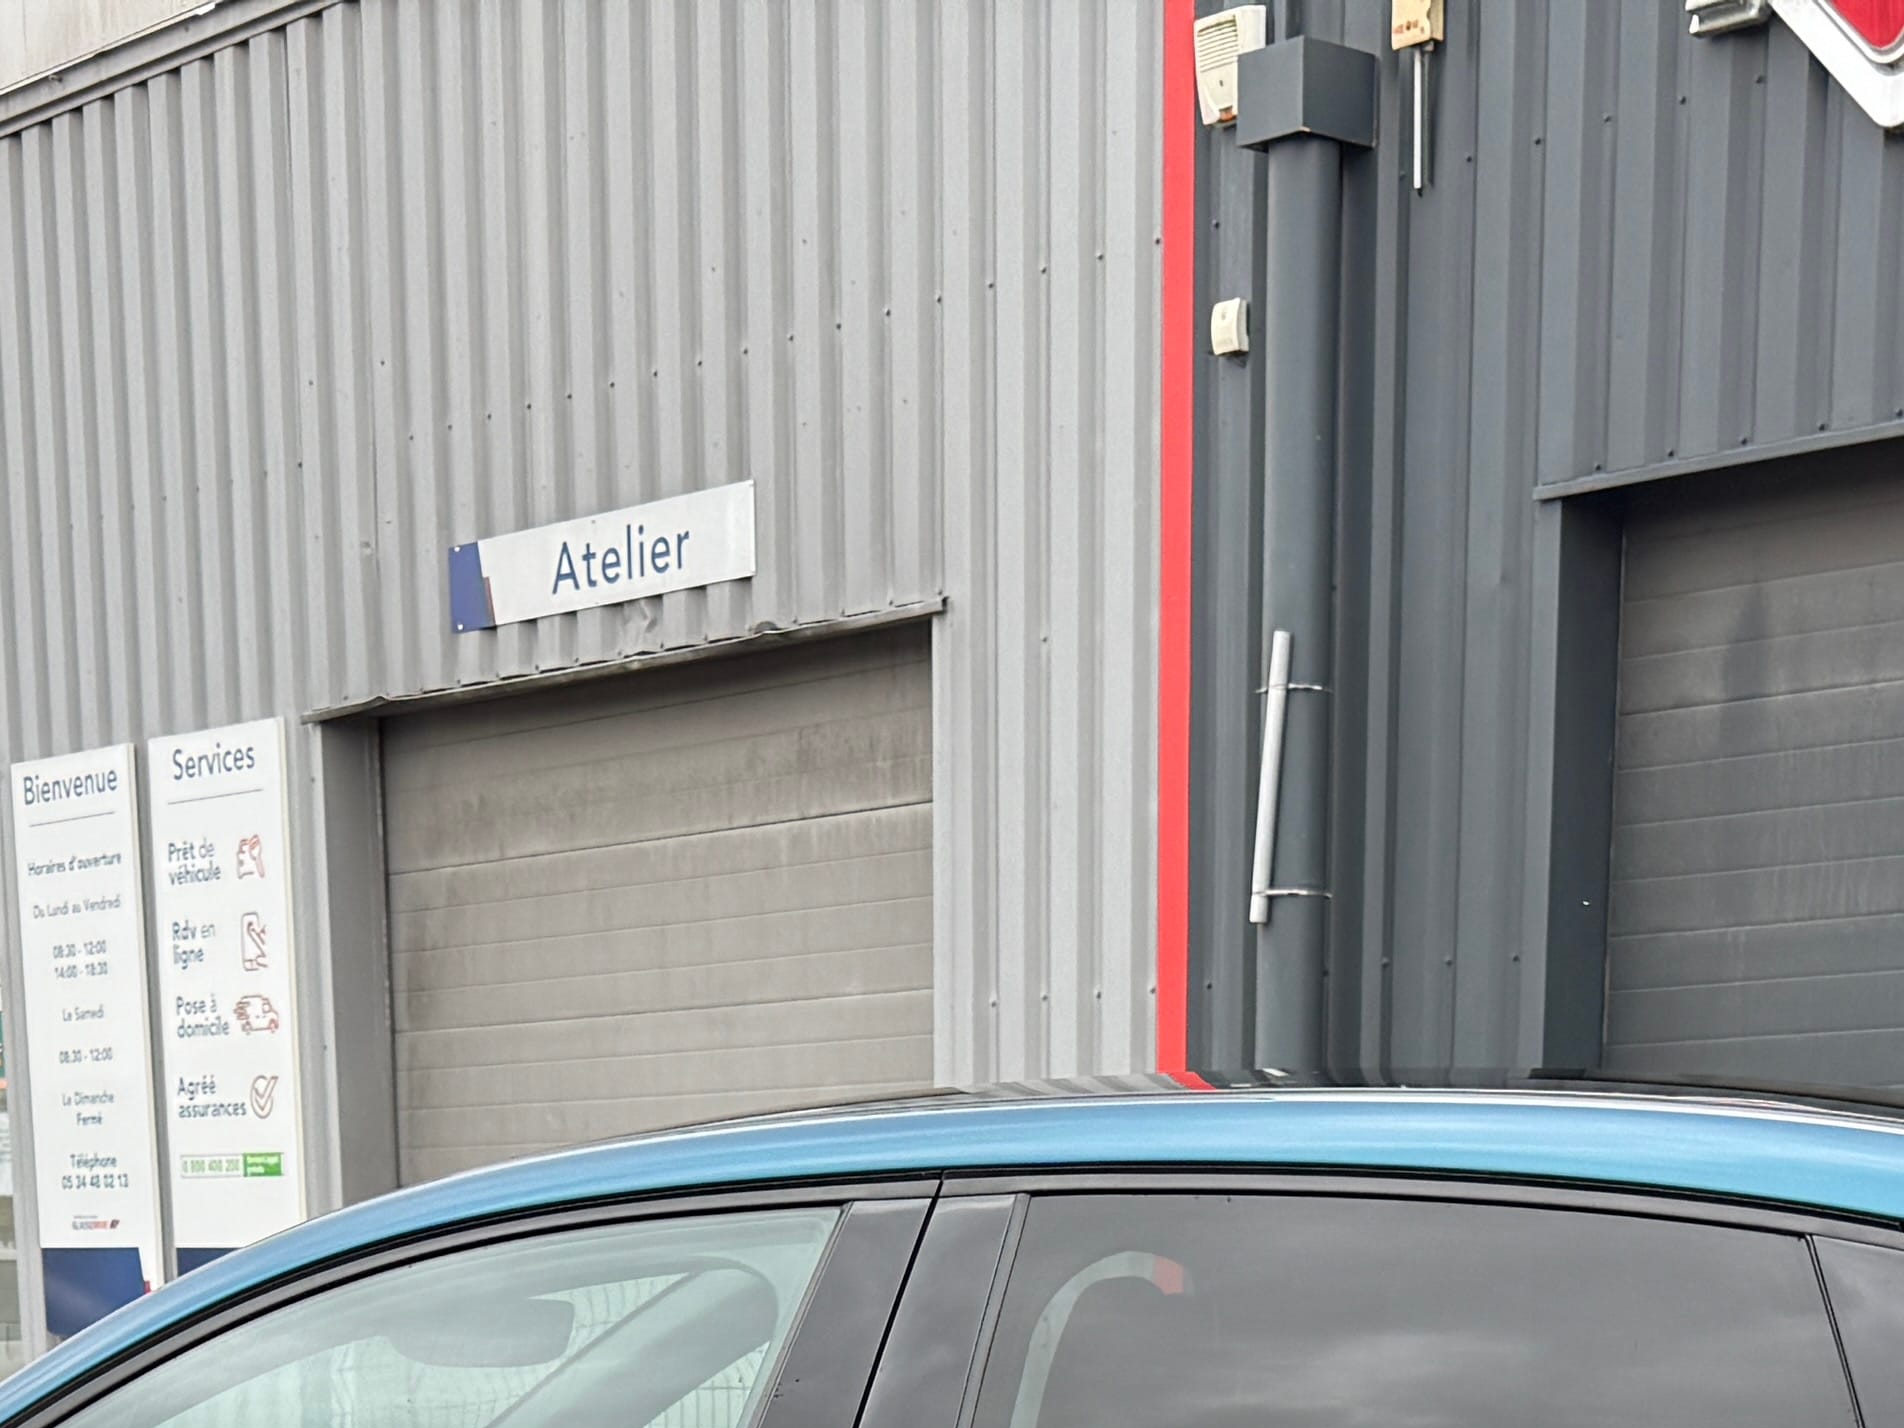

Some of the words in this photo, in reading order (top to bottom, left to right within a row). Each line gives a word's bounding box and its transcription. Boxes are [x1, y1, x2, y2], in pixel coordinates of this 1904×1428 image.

[552, 523, 690, 594] Atelier
[172, 743, 256, 781] Services
[23, 769, 118, 806] Bienvenue
[168, 841, 196, 863] Prêt
[199, 837, 215, 859] de
[168, 862, 222, 886] véhicule
[172, 920, 197, 942] Rdv
[200, 922, 216, 939] en
[173, 943, 205, 970] ligne
[176, 995, 208, 1016] Pose
[176, 1016, 230, 1038] domicile
[178, 1101, 247, 1119] assurances
